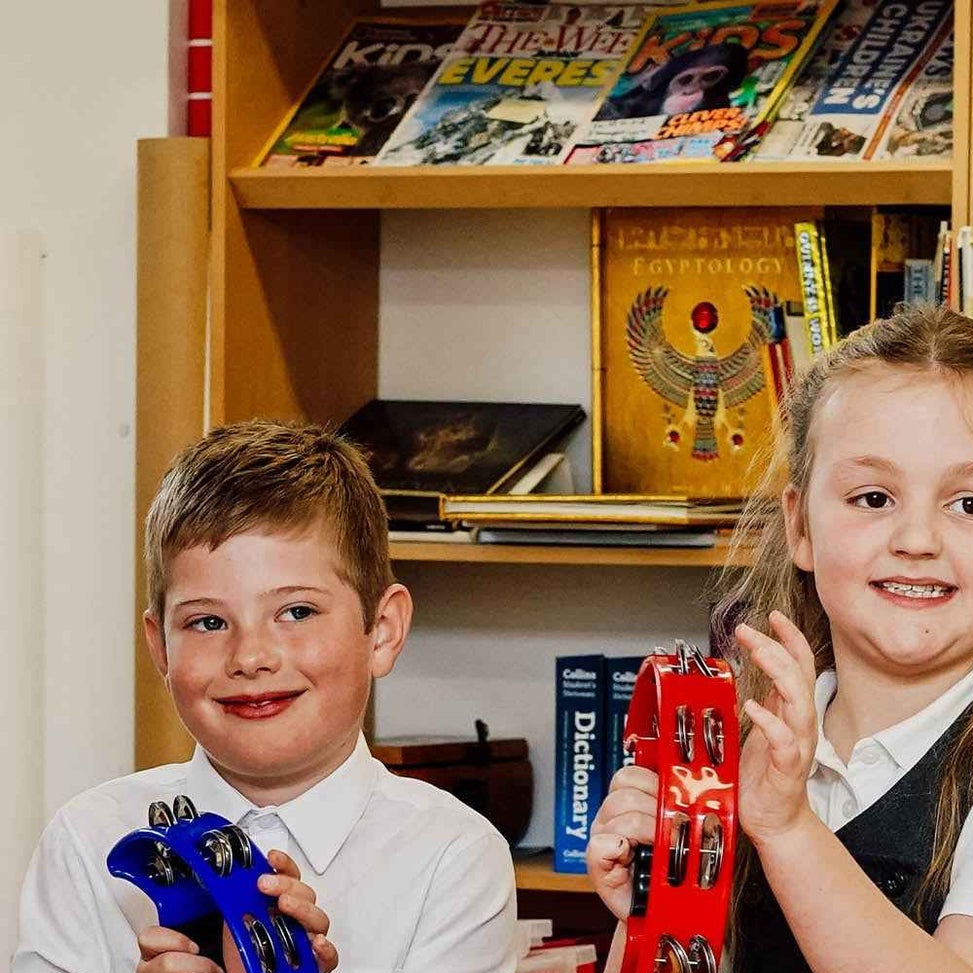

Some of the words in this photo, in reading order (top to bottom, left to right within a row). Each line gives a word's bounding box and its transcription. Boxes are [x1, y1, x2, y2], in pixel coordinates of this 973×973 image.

[822, 3, 907, 105] CHILDREN
[633, 257, 787, 275] EGYPTOLOGY
[565, 711, 597, 841] Dictionary
